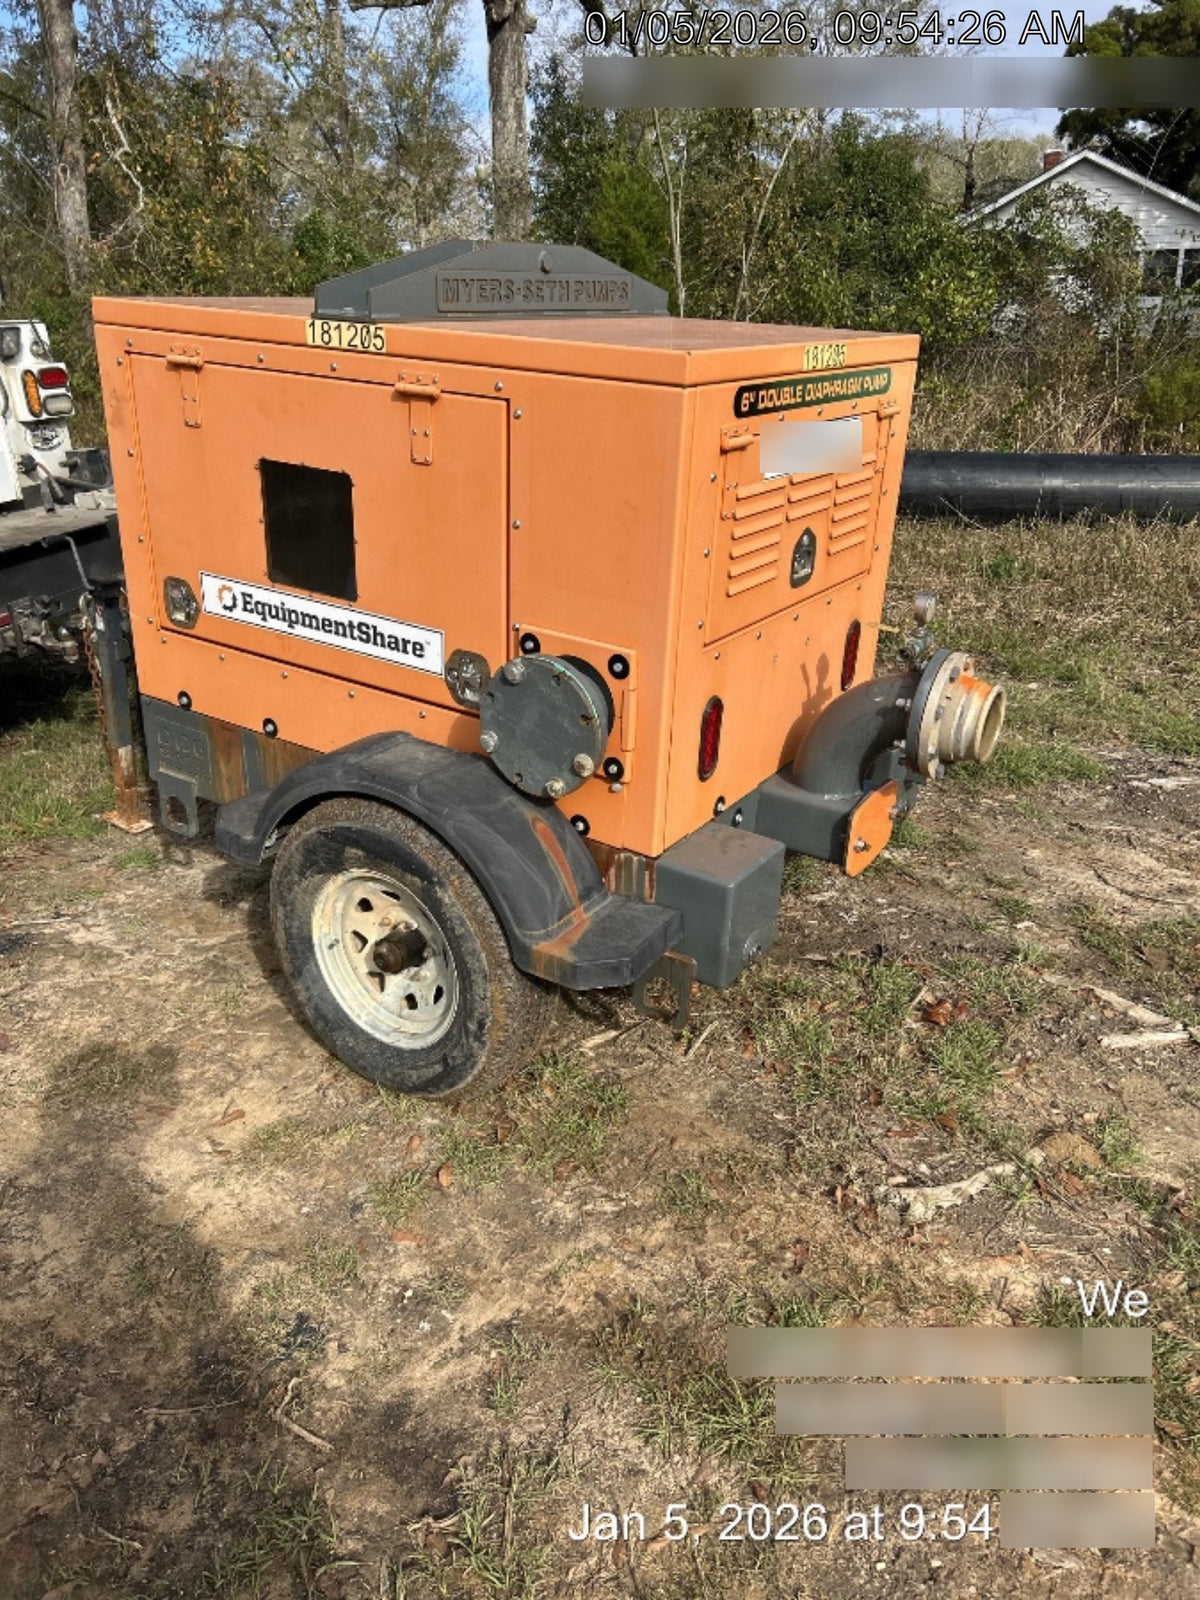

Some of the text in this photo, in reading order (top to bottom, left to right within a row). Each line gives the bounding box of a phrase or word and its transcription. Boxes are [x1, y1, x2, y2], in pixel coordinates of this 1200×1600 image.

[573, 279, 629, 303] PUMPS
[308, 319, 385, 351] 181205
[757, 384, 802, 410] DOUBLE
[804, 376, 863, 401] DIAPHRAGM
[863, 372, 888, 394] PUMP
[240, 591, 425, 659] EquipmentShare
